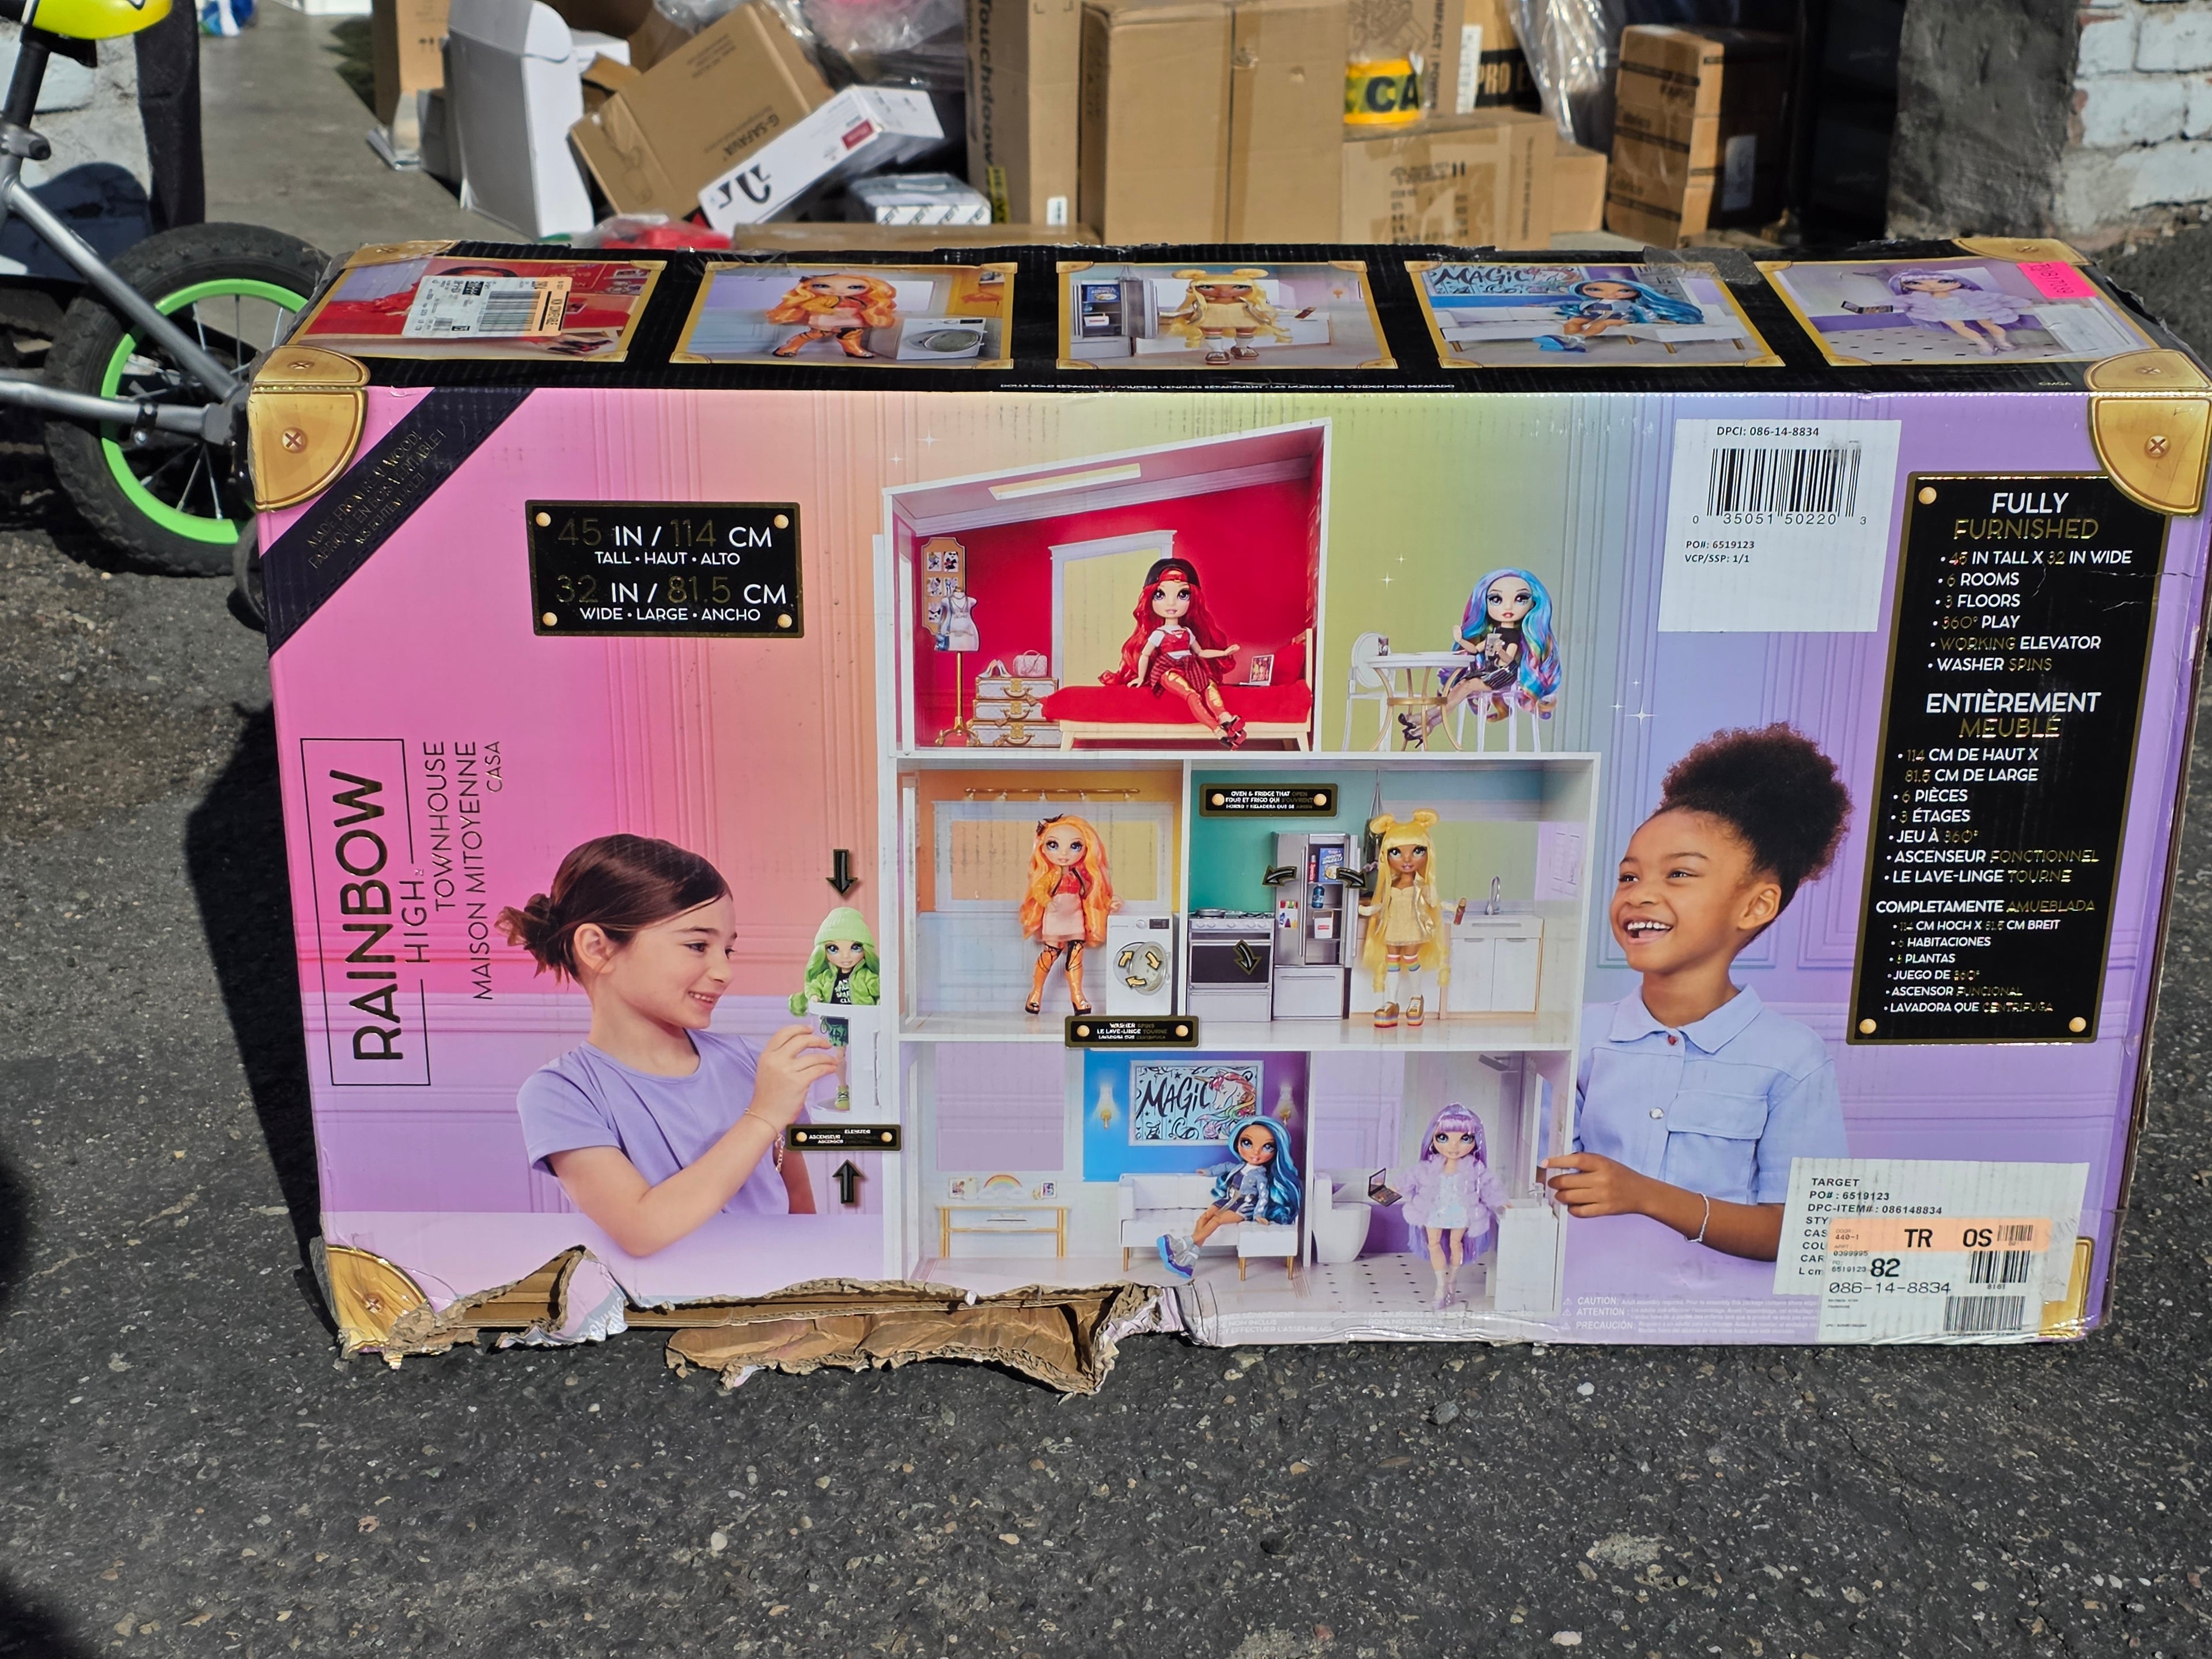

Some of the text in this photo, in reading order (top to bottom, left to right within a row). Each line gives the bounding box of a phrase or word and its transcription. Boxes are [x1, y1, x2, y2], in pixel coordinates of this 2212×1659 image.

[1717, 427, 1820, 436] DPCI: 086-14-8834
[1991, 492, 2069, 514] FULLY
[558, 518, 602, 546] 45
[671, 519, 717, 547] 114
[729, 527, 772, 547] CM
[1953, 518, 2099, 540] FURNISHED
[1713, 541, 1755, 550] 6519123
[594, 551, 740, 565] TALL HAUT ALTO
[1685, 554, 1750, 564] VCP/SSP: 1/1
[1972, 551, 1989, 565] IN
[1994, 551, 2029, 565] TALL
[2032, 551, 2044, 565] X
[2047, 551, 2066, 565] 32
[2069, 551, 2086, 564] IN
[2090, 550, 2133, 563] WIDE
[1960, 572, 2020, 586] ROOMS
[555, 574, 599, 603] 32
[667, 575, 730, 604] 81.5
[743, 584, 786, 604] CM
[1957, 594, 2021, 608] FLOORS
[579, 607, 760, 622] WIDE LARGE ANCHO
[1982, 615, 2021, 629] PLAY
[1939, 636, 2101, 651] WORKING ELEVATOR
[1937, 658, 2052, 671] WASHER SPINS
[1926, 688, 2101, 713] ENTIÈREMENT
[1959, 714, 2061, 738] MEUBLÉ
[1929, 748, 1953, 761] CM
[1957, 748, 1979, 761] DE
[1983, 748, 2024, 761] HAUT
[2026, 748, 2039, 760] X
[484, 741, 503, 793] CASA
[1934, 769, 1959, 782] CM
[1963, 769, 1985, 781] DE
[1988, 768, 2039, 781] LARGE
[1915, 787, 1968, 802] PIÈCES
[1912, 808, 1971, 822] ÉTAGES
[422, 741, 456, 912] TOWNHOUSE
[1896, 831, 1925, 843] JEU
[1893, 851, 1986, 863] ASCENSEUR
[454, 741, 494, 999] MAISON MITOYENNE
[1892, 870, 1911, 882] LE
[1915, 870, 2005, 882] LAVE-LINGE
[1876, 900, 2005, 913] COMPLETAMENTE
[329, 770, 403, 1060] RAINBOW
[399, 881, 430, 963] HIGH
[1916, 921, 1934, 930] CM
[1937, 921, 1972, 930] HOCH
[1974, 921, 1982, 930] X
[2006, 920, 2026, 930] CM
[2028, 920, 2061, 930] BREIT
[1907, 937, 1991, 946] HABITACIONES
[1905, 954, 1956, 963] PLANTAS
[1893, 971, 1932, 980] JUEGO
[1934, 970, 1951, 980] DE
[1891, 987, 1954, 996] ASCENSOR
[1890, 1003, 1952, 1013] LAVADORA
[1954, 1002, 1980, 1013] QUE
[1812, 1178, 1860, 1187] TARGET
[1842, 1192, 1889, 1200] 6519123
[1882, 1206, 1942, 1214] 086148834
[1904, 1229, 1933, 1248] TR
[1871, 1258, 1900, 1278] 82
[1830, 1282, 1951, 1295] 086-14-8834
